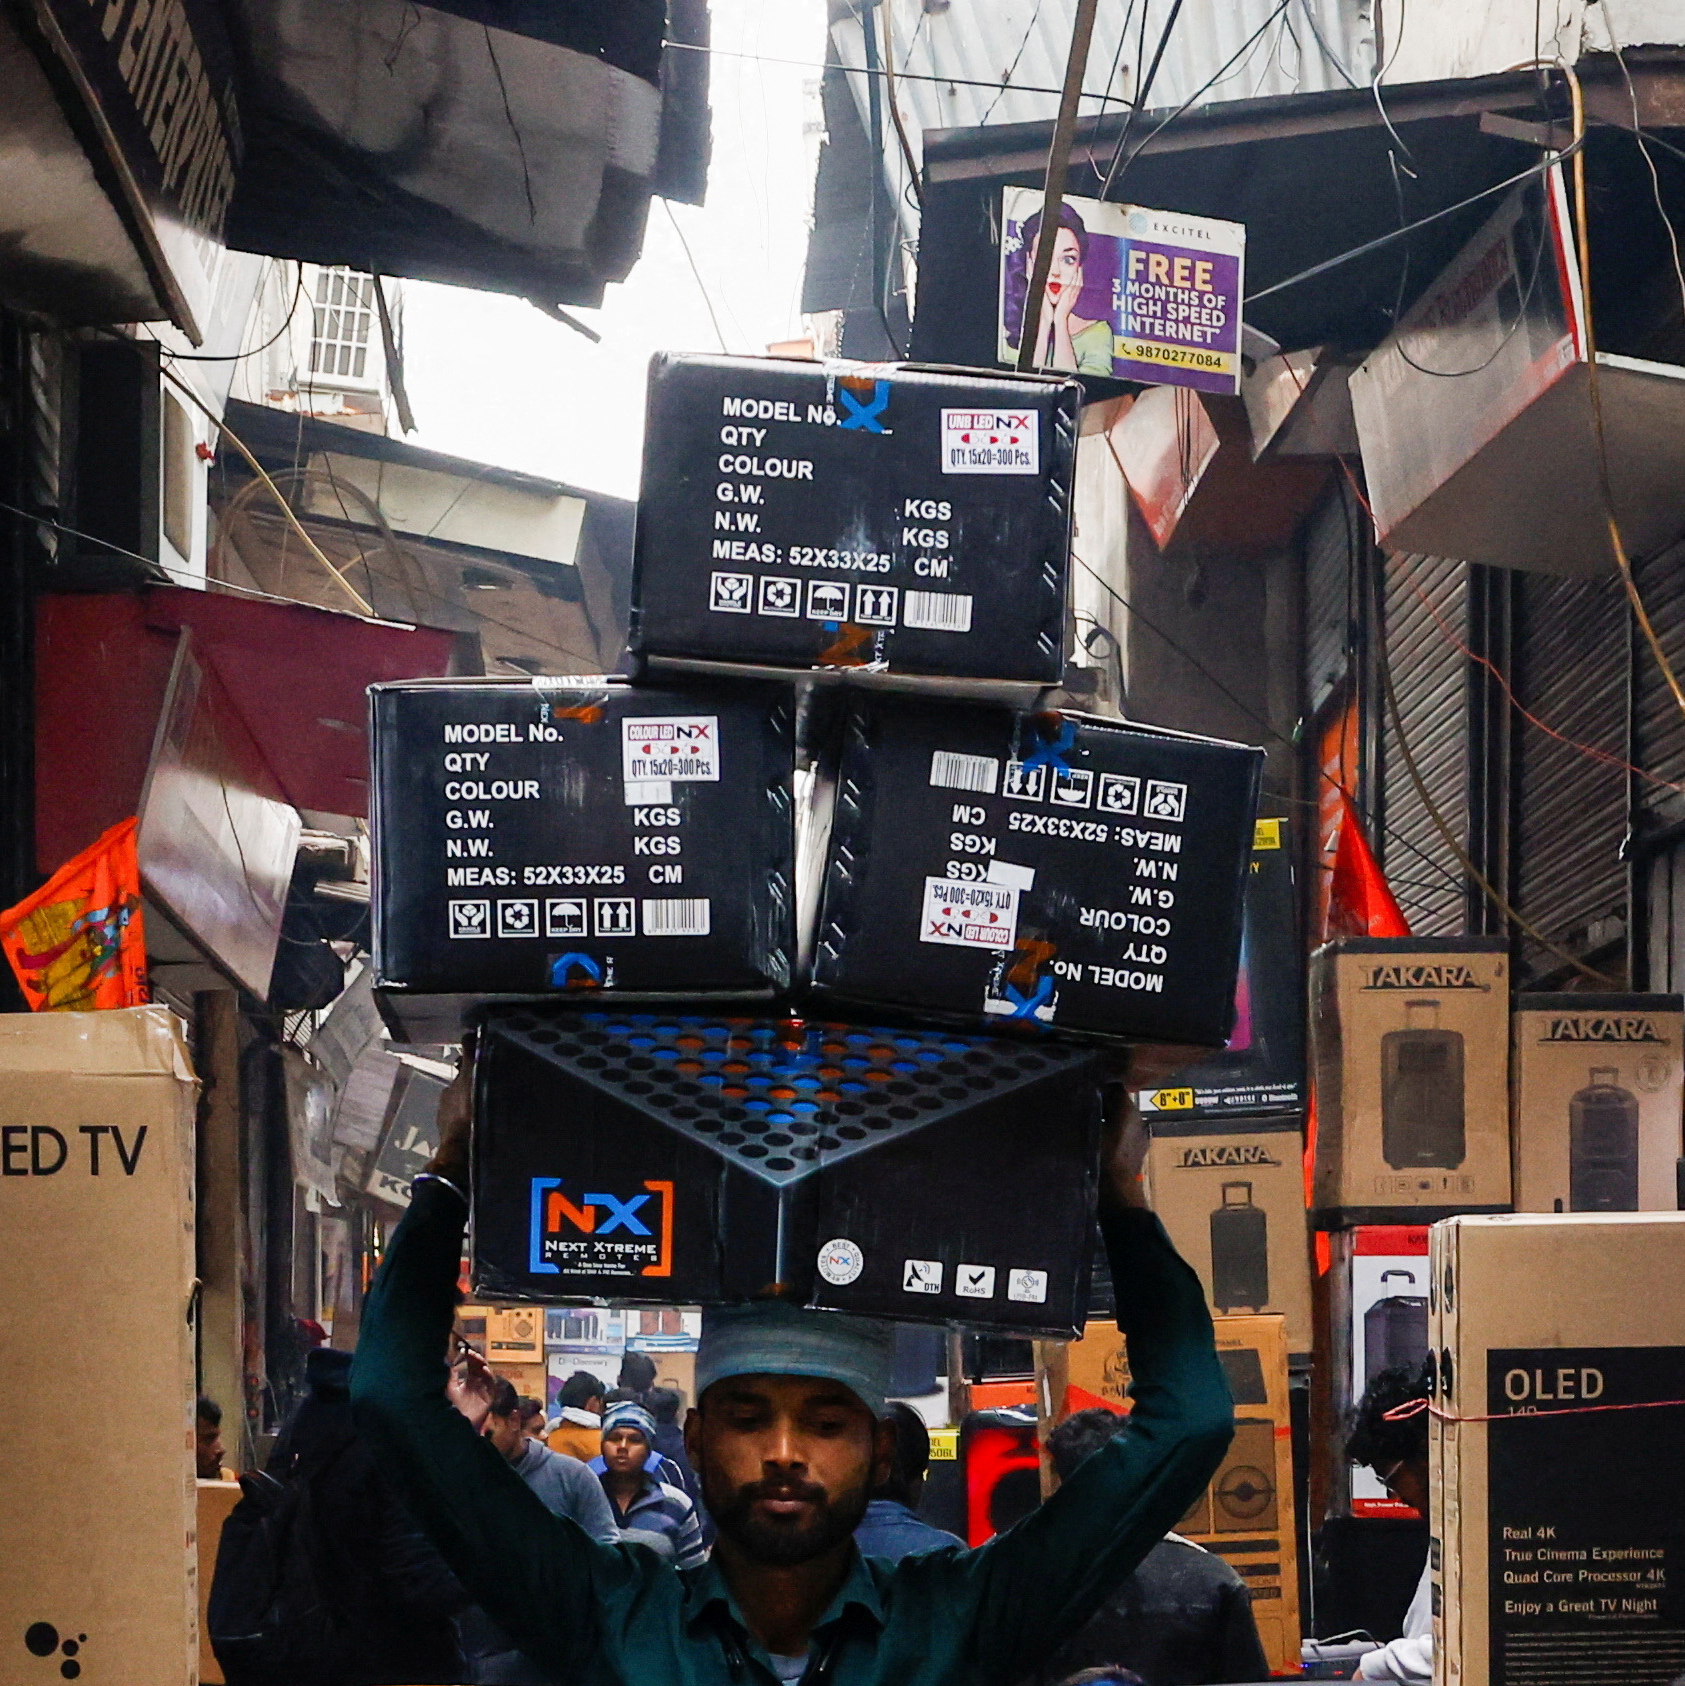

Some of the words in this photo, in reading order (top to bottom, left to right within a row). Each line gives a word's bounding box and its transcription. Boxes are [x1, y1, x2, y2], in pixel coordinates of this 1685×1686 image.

[1153, 222, 1212, 240] EXCITEL
[1128, 249, 1215, 292] FREE
[1111, 278, 1122, 292] 3
[1126, 282, 1200, 305] MONTHS
[1203, 293, 1227, 310] OF
[1112, 294, 1165, 317] HIGH
[1166, 303, 1226, 327] SPEED
[1135, 344, 1222, 368] 9870277084
[723, 396, 802, 423] MODEL
[807, 403, 842, 427] No.
[997, 414, 1031, 430] NX
[720, 426, 767, 447] QTY
[718, 454, 814, 480] COLOUR
[950, 448, 967, 467] QTY.
[968, 448, 1014, 466] 15x20=300
[1015, 450, 1032, 466] Pcs.
[716, 483, 766, 506] G.W.
[904, 498, 952, 521] KGS
[714, 511, 762, 534] N.W.
[902, 527, 950, 549] KGS
[712, 540, 783, 565] MEAS:
[788, 546, 892, 574] 52X33X25
[913, 557, 950, 579] CM
[444, 724, 523, 742] MODEL
[528, 723, 564, 742] No.
[676, 724, 710, 739] NX
[444, 753, 490, 773] QTY
[632, 760, 649, 776] QTY.
[649, 759, 695, 775] 15x20=300
[696, 760, 713, 775] Pcs.
[445, 781, 540, 800] COLOUR
[446, 810, 494, 829] G.W.
[634, 808, 681, 827] KGS
[952, 804, 986, 825] CM
[1008, 812, 1109, 843] 52X33X25
[446, 840, 494, 857] N.W.
[634, 837, 681, 855] KGS
[950, 832, 997, 856] KGS
[1114, 827, 1182, 853] MEAS:
[447, 867, 518, 886] MEAS:
[523, 866, 626, 885] 52X33X25
[648, 865, 683, 884] CM
[1133, 857, 1178, 881] N.W.
[951, 886, 996, 907] 15x20=300
[1128, 885, 1174, 909] G.W.
[929, 920, 963, 938] NX
[1079, 907, 1171, 937] COLOUR
[1122, 942, 1168, 964] QTY
[1049, 960, 1082, 982] No.
[1088, 964, 1164, 993] MODEL
[1359, 966, 1480, 988] TAKARA
[1539, 1018, 1663, 1042] TAKARA
[82, 1125, 148, 1176] TV
[1175, 1146, 1276, 1167] TAKARA
[546, 1191, 654, 1236] NX
[830, 1256, 851, 1266] NX
[962, 1285, 986, 1295] RoHS
[1504, 1367, 1604, 1400] OLED
[1503, 1526, 1532, 1540] Real
[1537, 1526, 1557, 1540] 4K
[1503, 1548, 1533, 1561] True
[1537, 1546, 1587, 1561] Cinema
[1592, 1545, 1665, 1563] Experience
[1503, 1570, 1539, 1584] Quad
[1543, 1569, 1574, 1584] Core
[1578, 1568, 1642, 1584] Processor
[1646, 1567, 1667, 1581] 4K
[1504, 1599, 1542, 1617] Enjoy
[1546, 1603, 1554, 1613] a
[1558, 1599, 1595, 1613] Great
[1600, 1598, 1617, 1612] TV
[1622, 1597, 1657, 1613] Night
